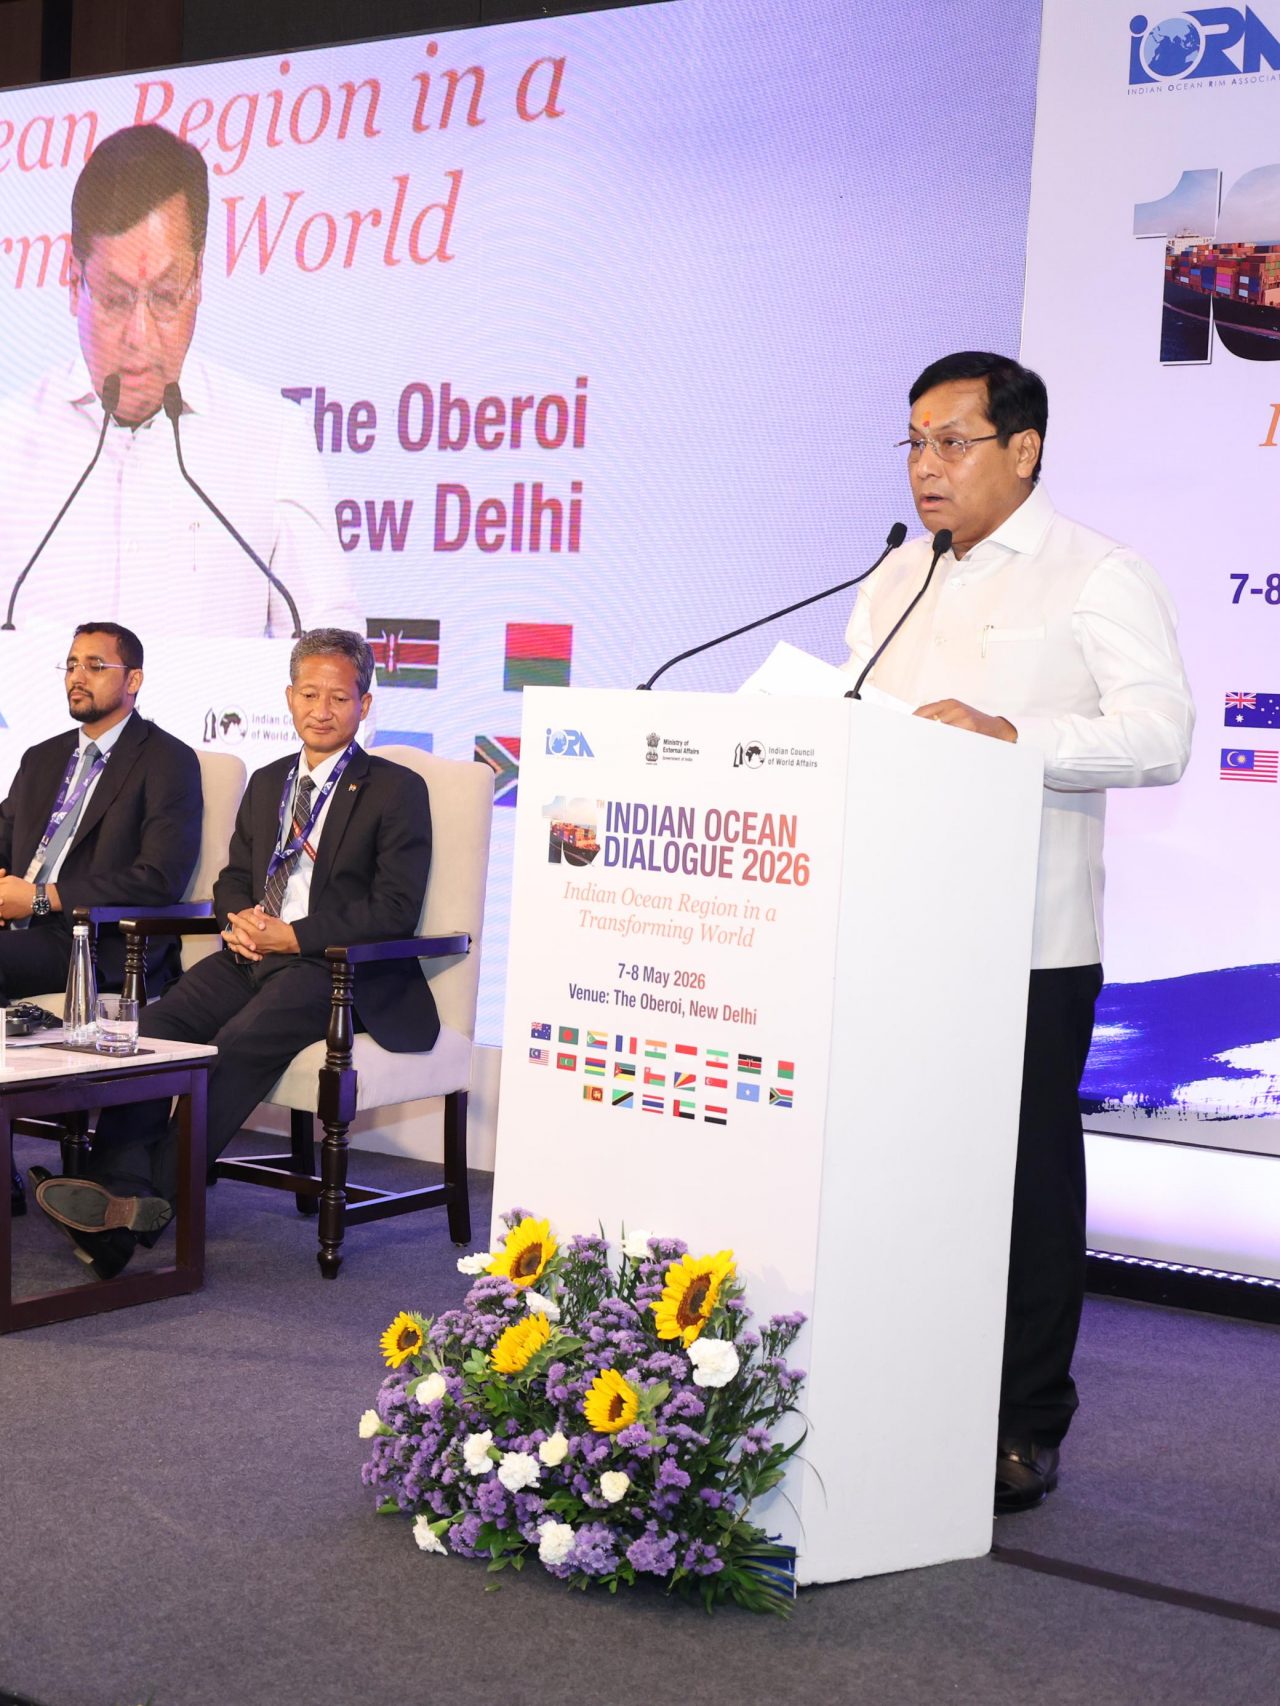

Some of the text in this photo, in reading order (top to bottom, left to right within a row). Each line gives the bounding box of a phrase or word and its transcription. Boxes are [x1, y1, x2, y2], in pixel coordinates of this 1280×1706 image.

[1127, 74, 1280, 96] INDIAN OCEAN RIM ASSOCIA
[134, 59, 382, 175] Region
[411, 40, 486, 134] in
[515, 55, 568, 123] a
[221, 168, 464, 278] World
[398, 375, 589, 452] Oberoi
[335, 480, 583, 553] ew Delhi
[252, 712, 280, 725] Indian
[263, 731, 288, 741] World
[662, 746, 682, 754] External
[663, 738, 682, 748] Ministry
[768, 746, 815, 756] Indian Council
[768, 758, 818, 768] of World Affairs
[605, 801, 695, 840] INDIAN
[704, 808, 798, 848] OCEAN
[603, 835, 811, 887] DIALOGUE 2026
[563, 881, 778, 922] Indian Ocean Region in a
[579, 909, 756, 948] Transforming World
[618, 962, 706, 990] 7-8 May 2026
[569, 983, 757, 1026] Venue: The Oberoi, New Delhi
